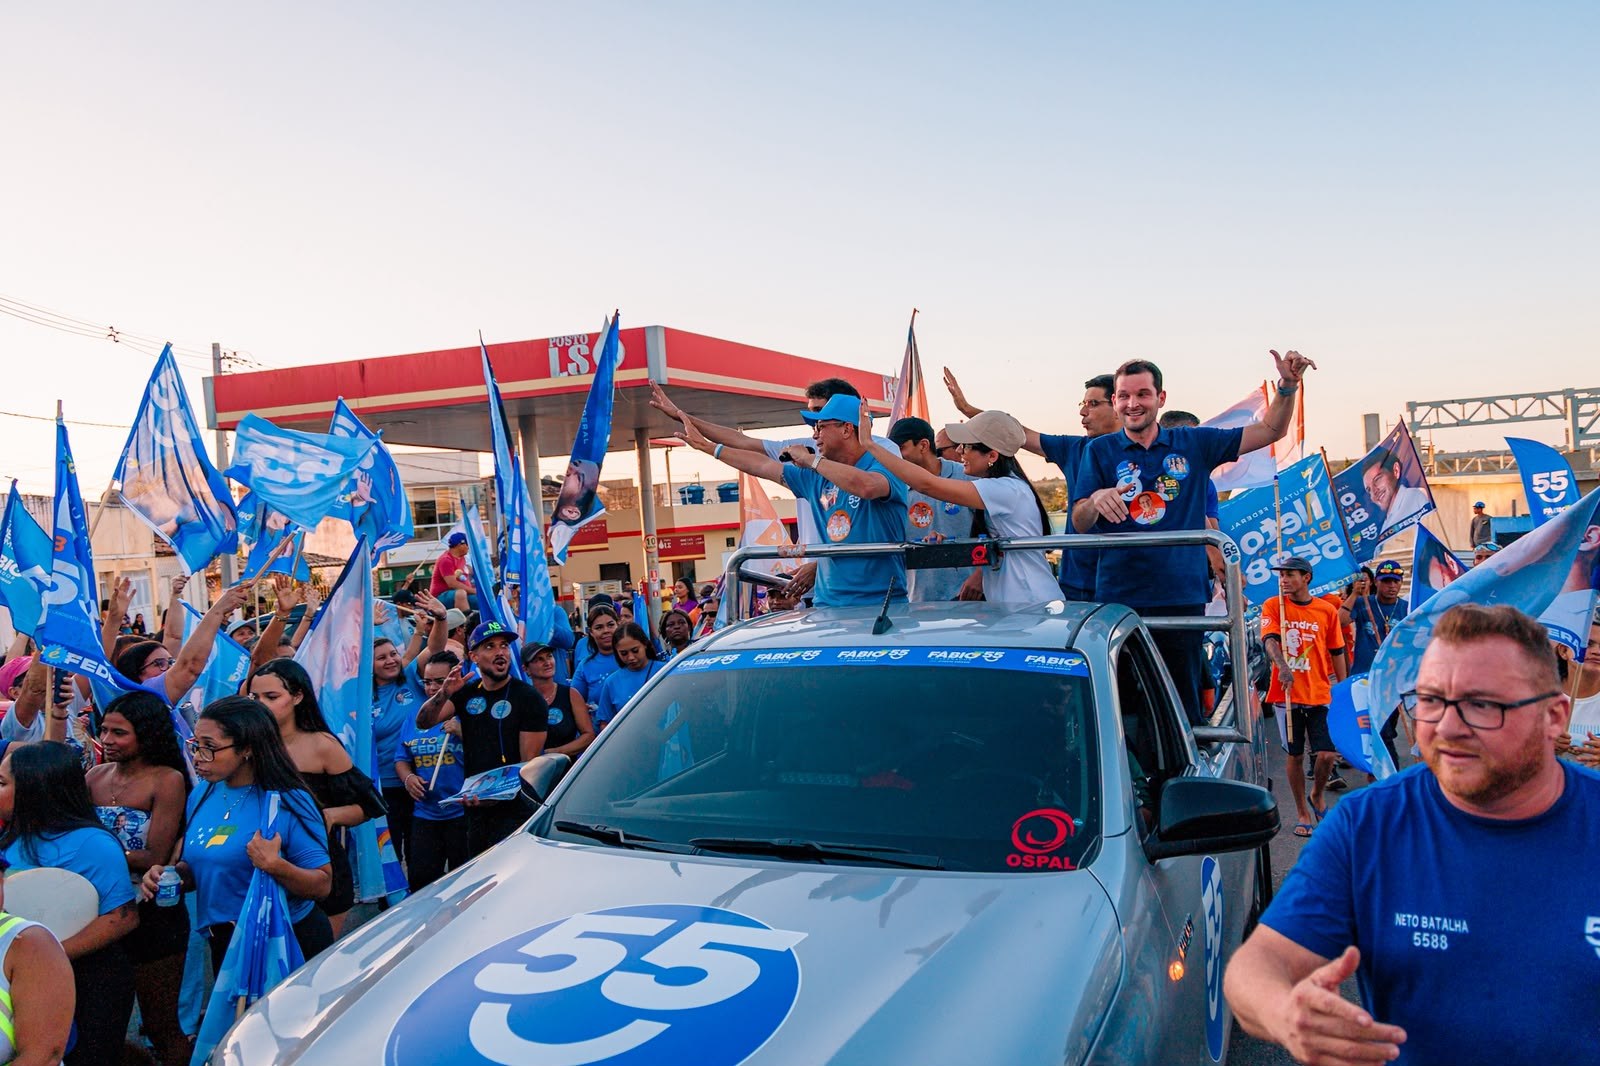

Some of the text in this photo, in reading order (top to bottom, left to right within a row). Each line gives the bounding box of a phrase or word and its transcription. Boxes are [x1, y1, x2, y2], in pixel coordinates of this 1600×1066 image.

[549, 334, 588, 347] POSTO
[548, 344, 590, 378] LS
[1532, 469, 1569, 494] 55
[1361, 523, 1378, 539] 55
[677, 656, 719, 668] FABIO
[720, 653, 741, 664] 55
[754, 649, 822, 661] FABIO 55
[837, 649, 910, 659] FABIO 55
[927, 650, 981, 659] FABIO
[982, 651, 1005, 662] 55
[1024, 655, 1081, 666] FABIO
[1006, 853, 1077, 870] OSPAL
[1395, 912, 1469, 934] NETO BATALHA
[1413, 931, 1448, 950] 5588
[474, 913, 809, 1011] 55
